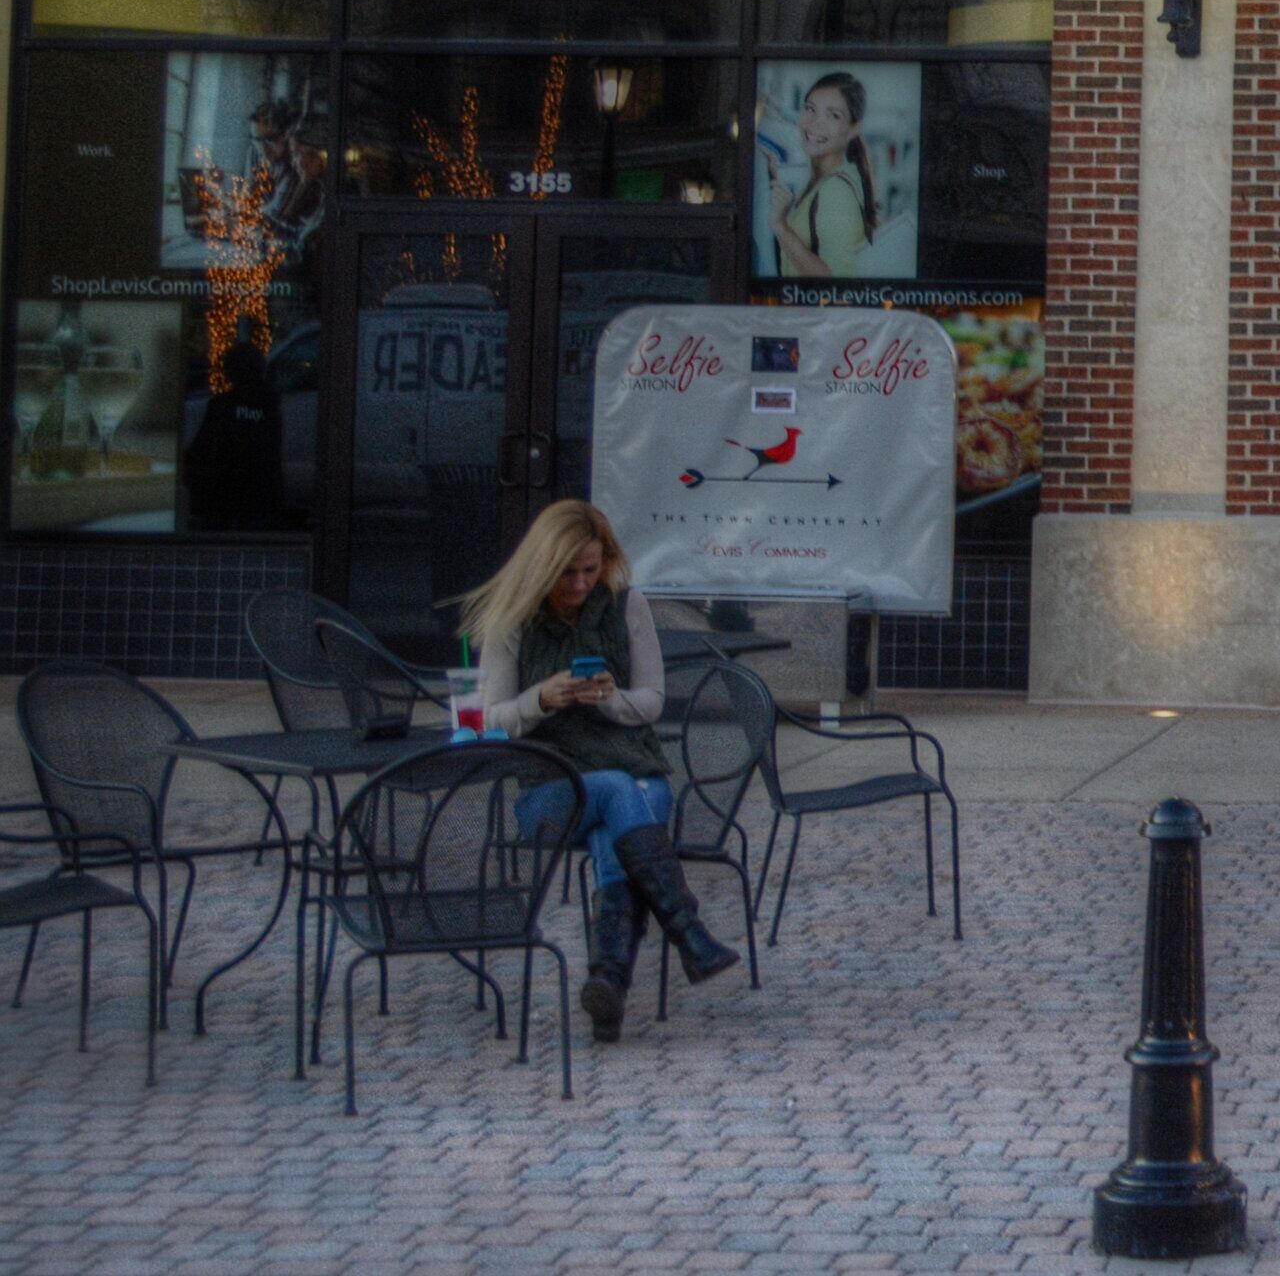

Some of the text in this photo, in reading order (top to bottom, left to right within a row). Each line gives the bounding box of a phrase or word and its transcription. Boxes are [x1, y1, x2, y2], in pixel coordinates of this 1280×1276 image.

[77, 144, 114, 158] Work.
[973, 164, 1008, 180] Shop.
[509, 172, 573, 194] 3155
[781, 284, 1024, 308] ShopLevisCommons.com
[627, 334, 724, 392] Selfie
[832, 338, 931, 396] Selfie
[620, 378, 677, 392] STATION
[825, 380, 881, 395] STATION
